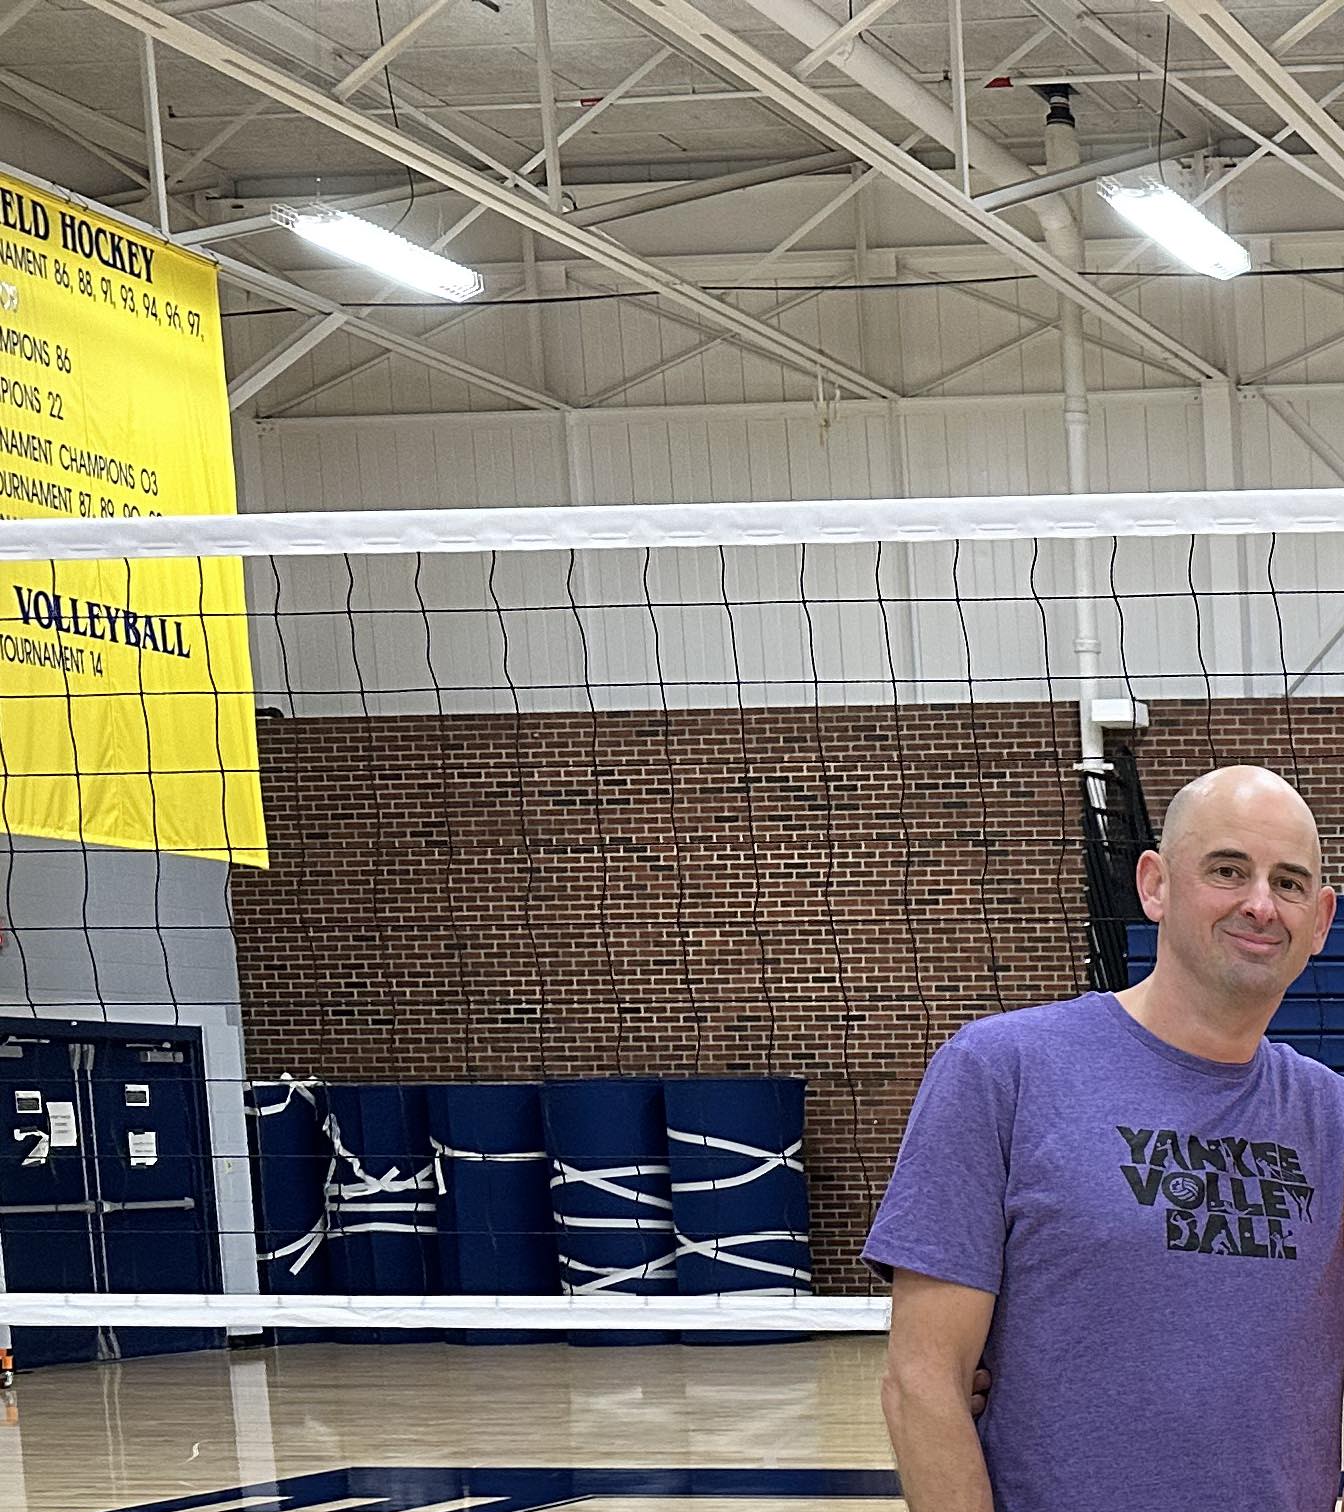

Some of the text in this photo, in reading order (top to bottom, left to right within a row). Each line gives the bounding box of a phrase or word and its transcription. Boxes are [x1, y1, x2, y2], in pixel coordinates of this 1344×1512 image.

[0, 187, 154, 284] ELD HOCKEY
[56, 345, 71, 373] 86
[48, 391, 63, 420] 22
[59, 444, 135, 489] CHAMPIONS
[13, 585, 190, 658] VOLLEYBALL
[90, 651, 103, 677] 14
[1116, 1126, 1307, 1184] YANKEE
[1120, 1165, 1314, 1223] VOLLEY
[1166, 1208, 1297, 1260] BALL
